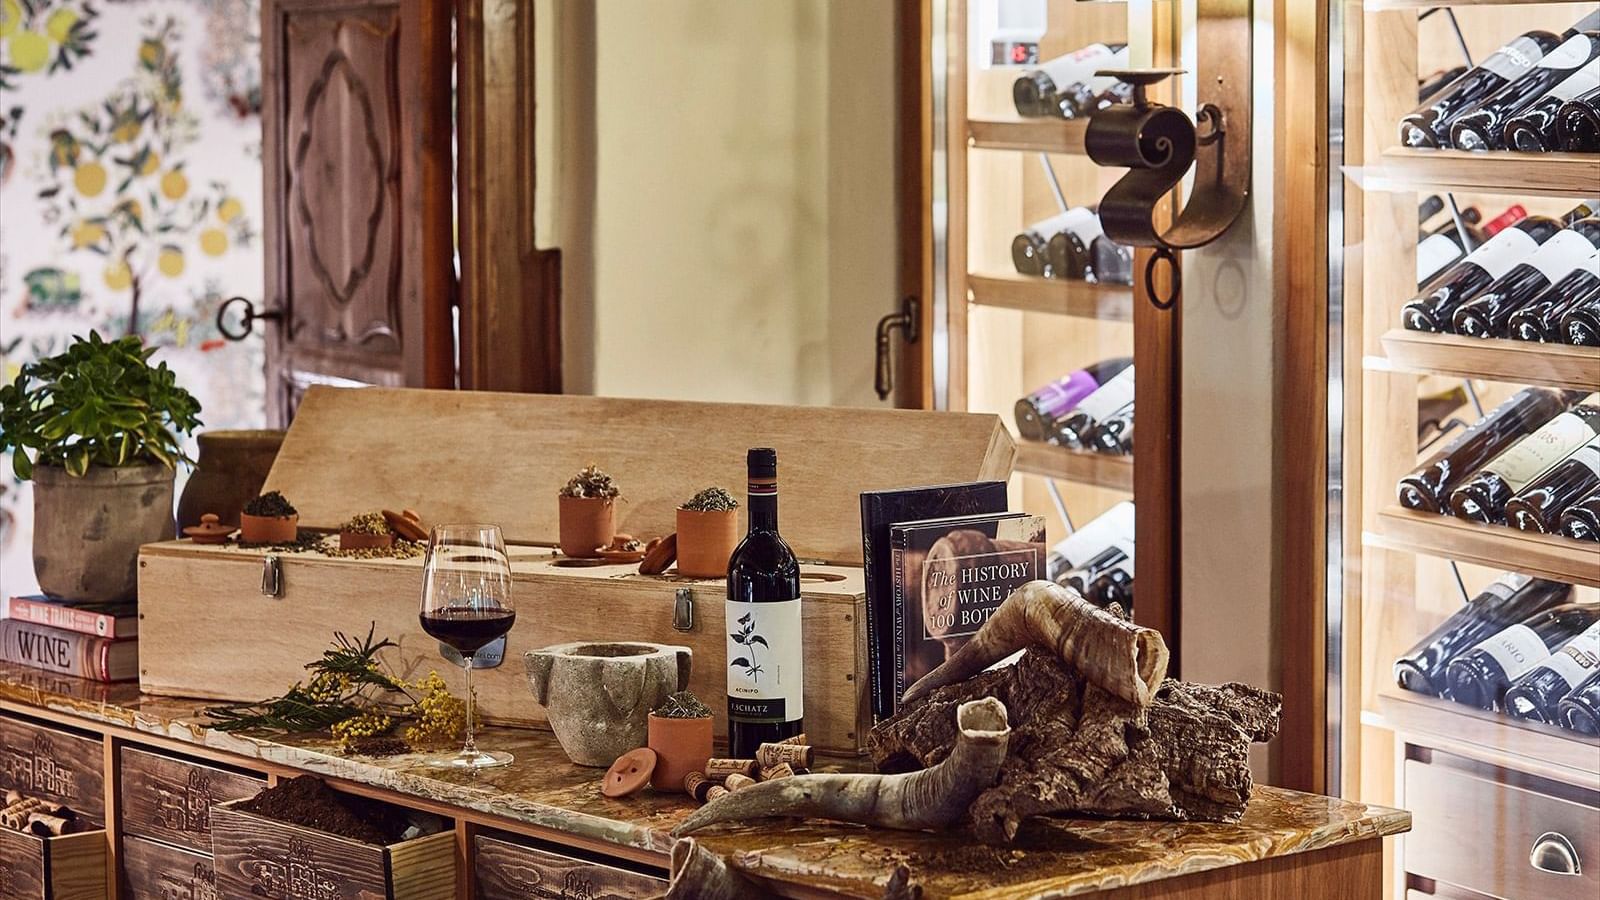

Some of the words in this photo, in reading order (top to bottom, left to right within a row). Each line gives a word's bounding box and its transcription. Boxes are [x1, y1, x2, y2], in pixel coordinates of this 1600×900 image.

[931, 571, 957, 587] The
[962, 562, 1029, 584] HISTORY
[939, 590, 955, 611] of
[958, 586, 1002, 604] WINE
[930, 613, 955, 629] 100
[17, 630, 71, 669] WINE
